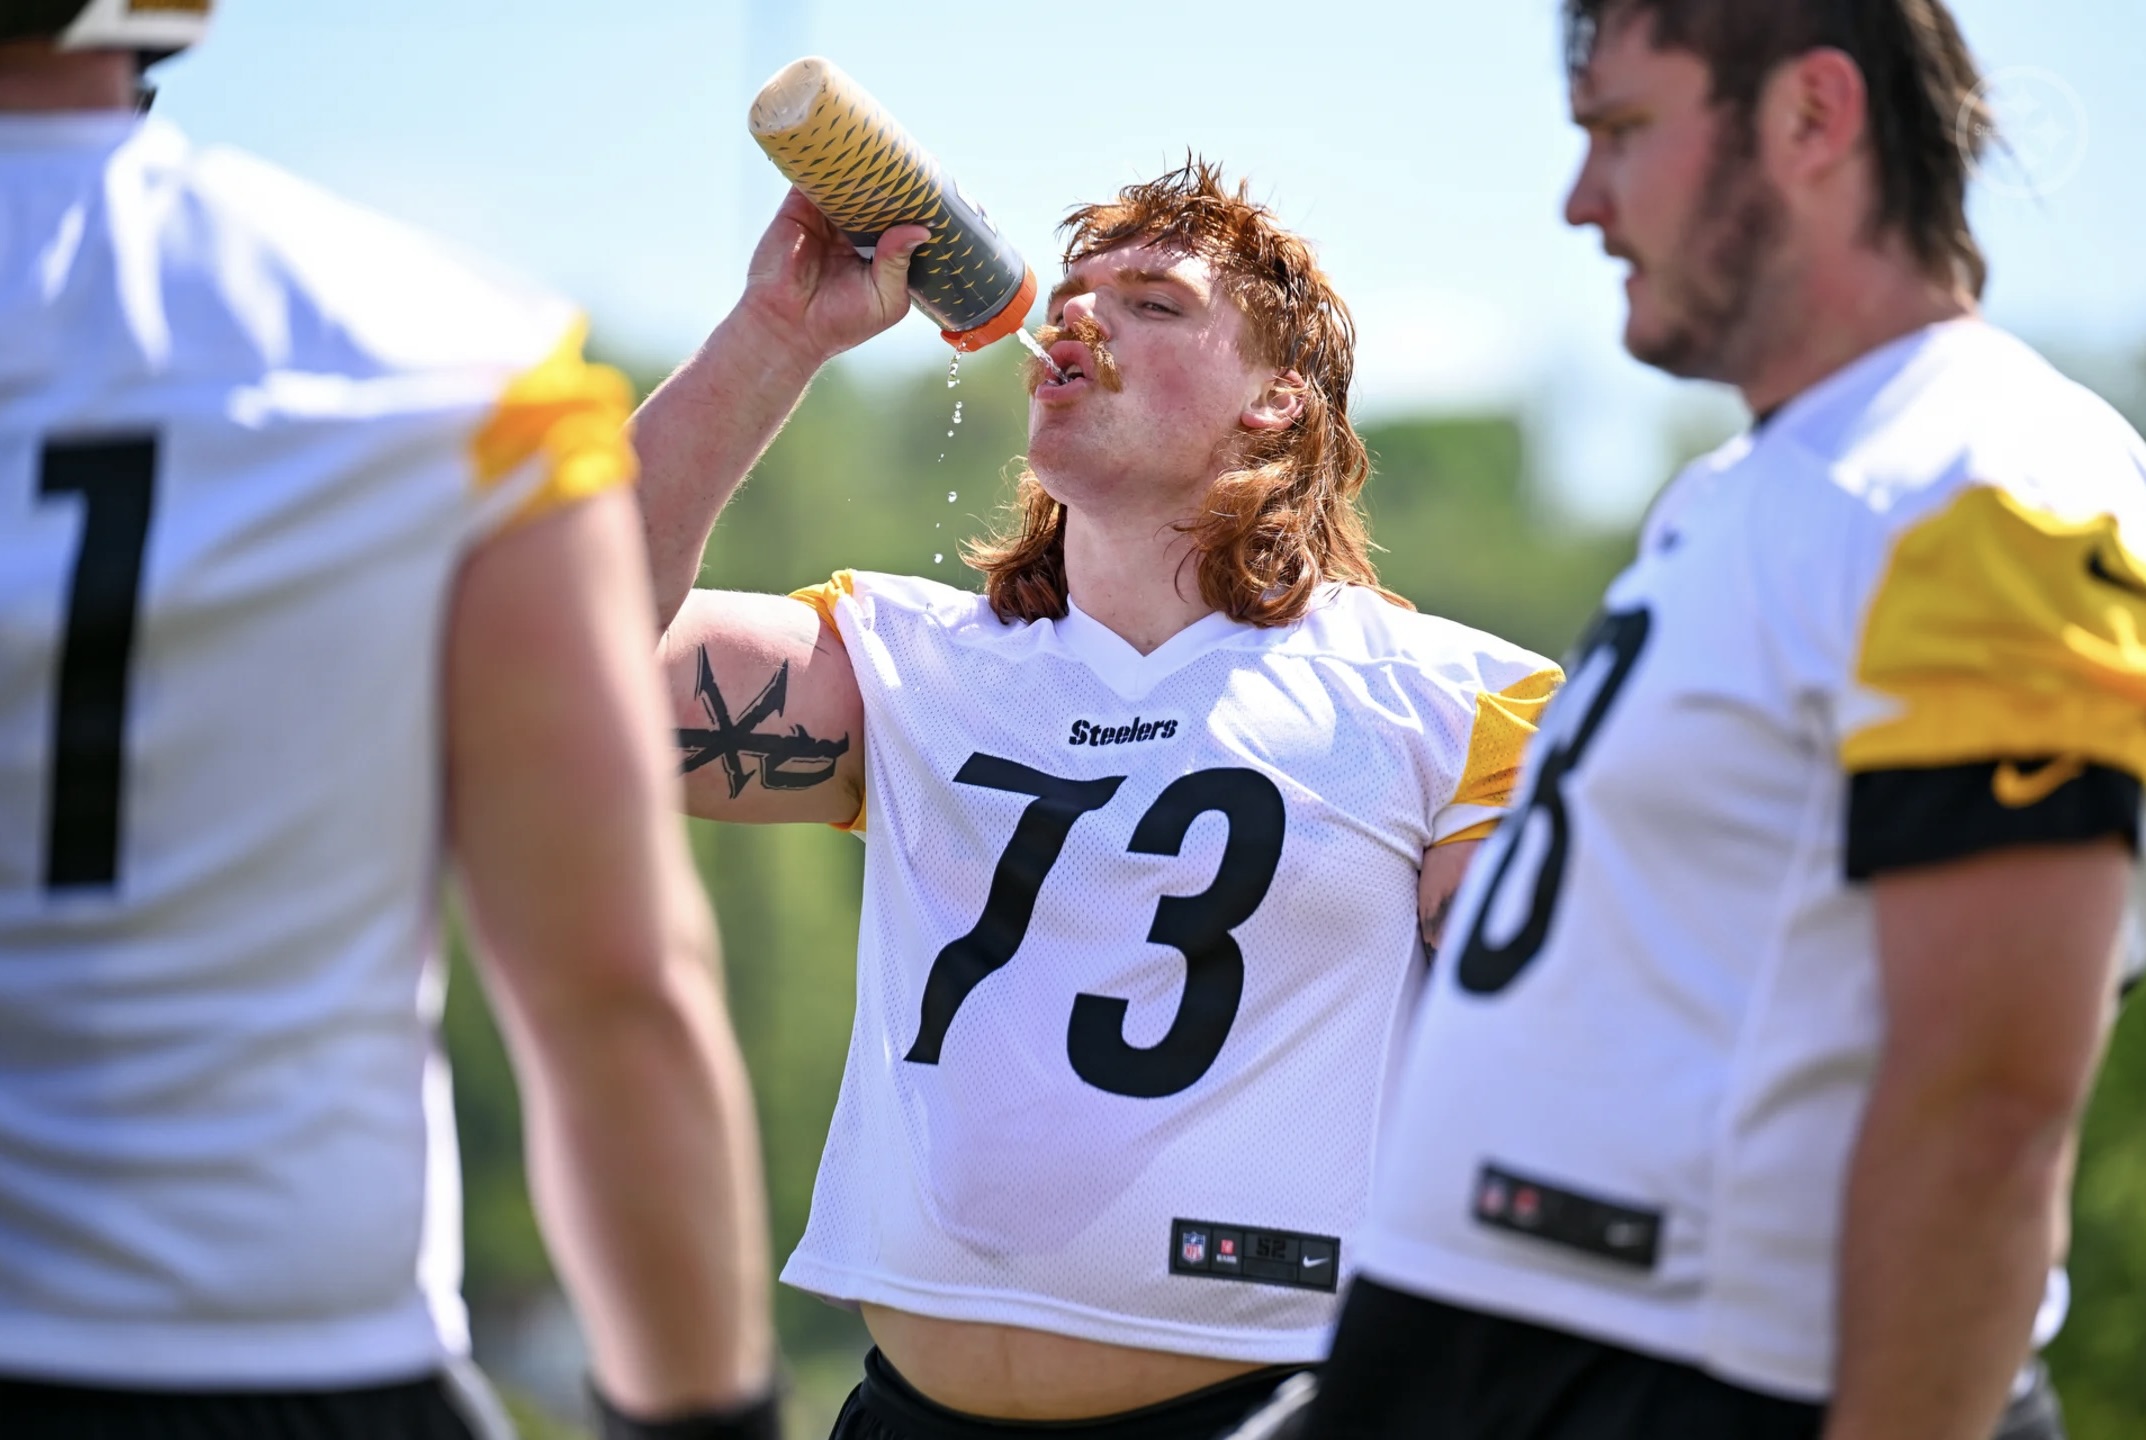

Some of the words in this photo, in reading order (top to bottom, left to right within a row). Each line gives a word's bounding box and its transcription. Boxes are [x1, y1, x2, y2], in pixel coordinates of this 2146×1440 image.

[38, 432, 162, 892] 1
[1069, 716, 1178, 747] Steelers
[903, 752, 1286, 1099] 73
[1256, 1236, 1287, 1259] 52
